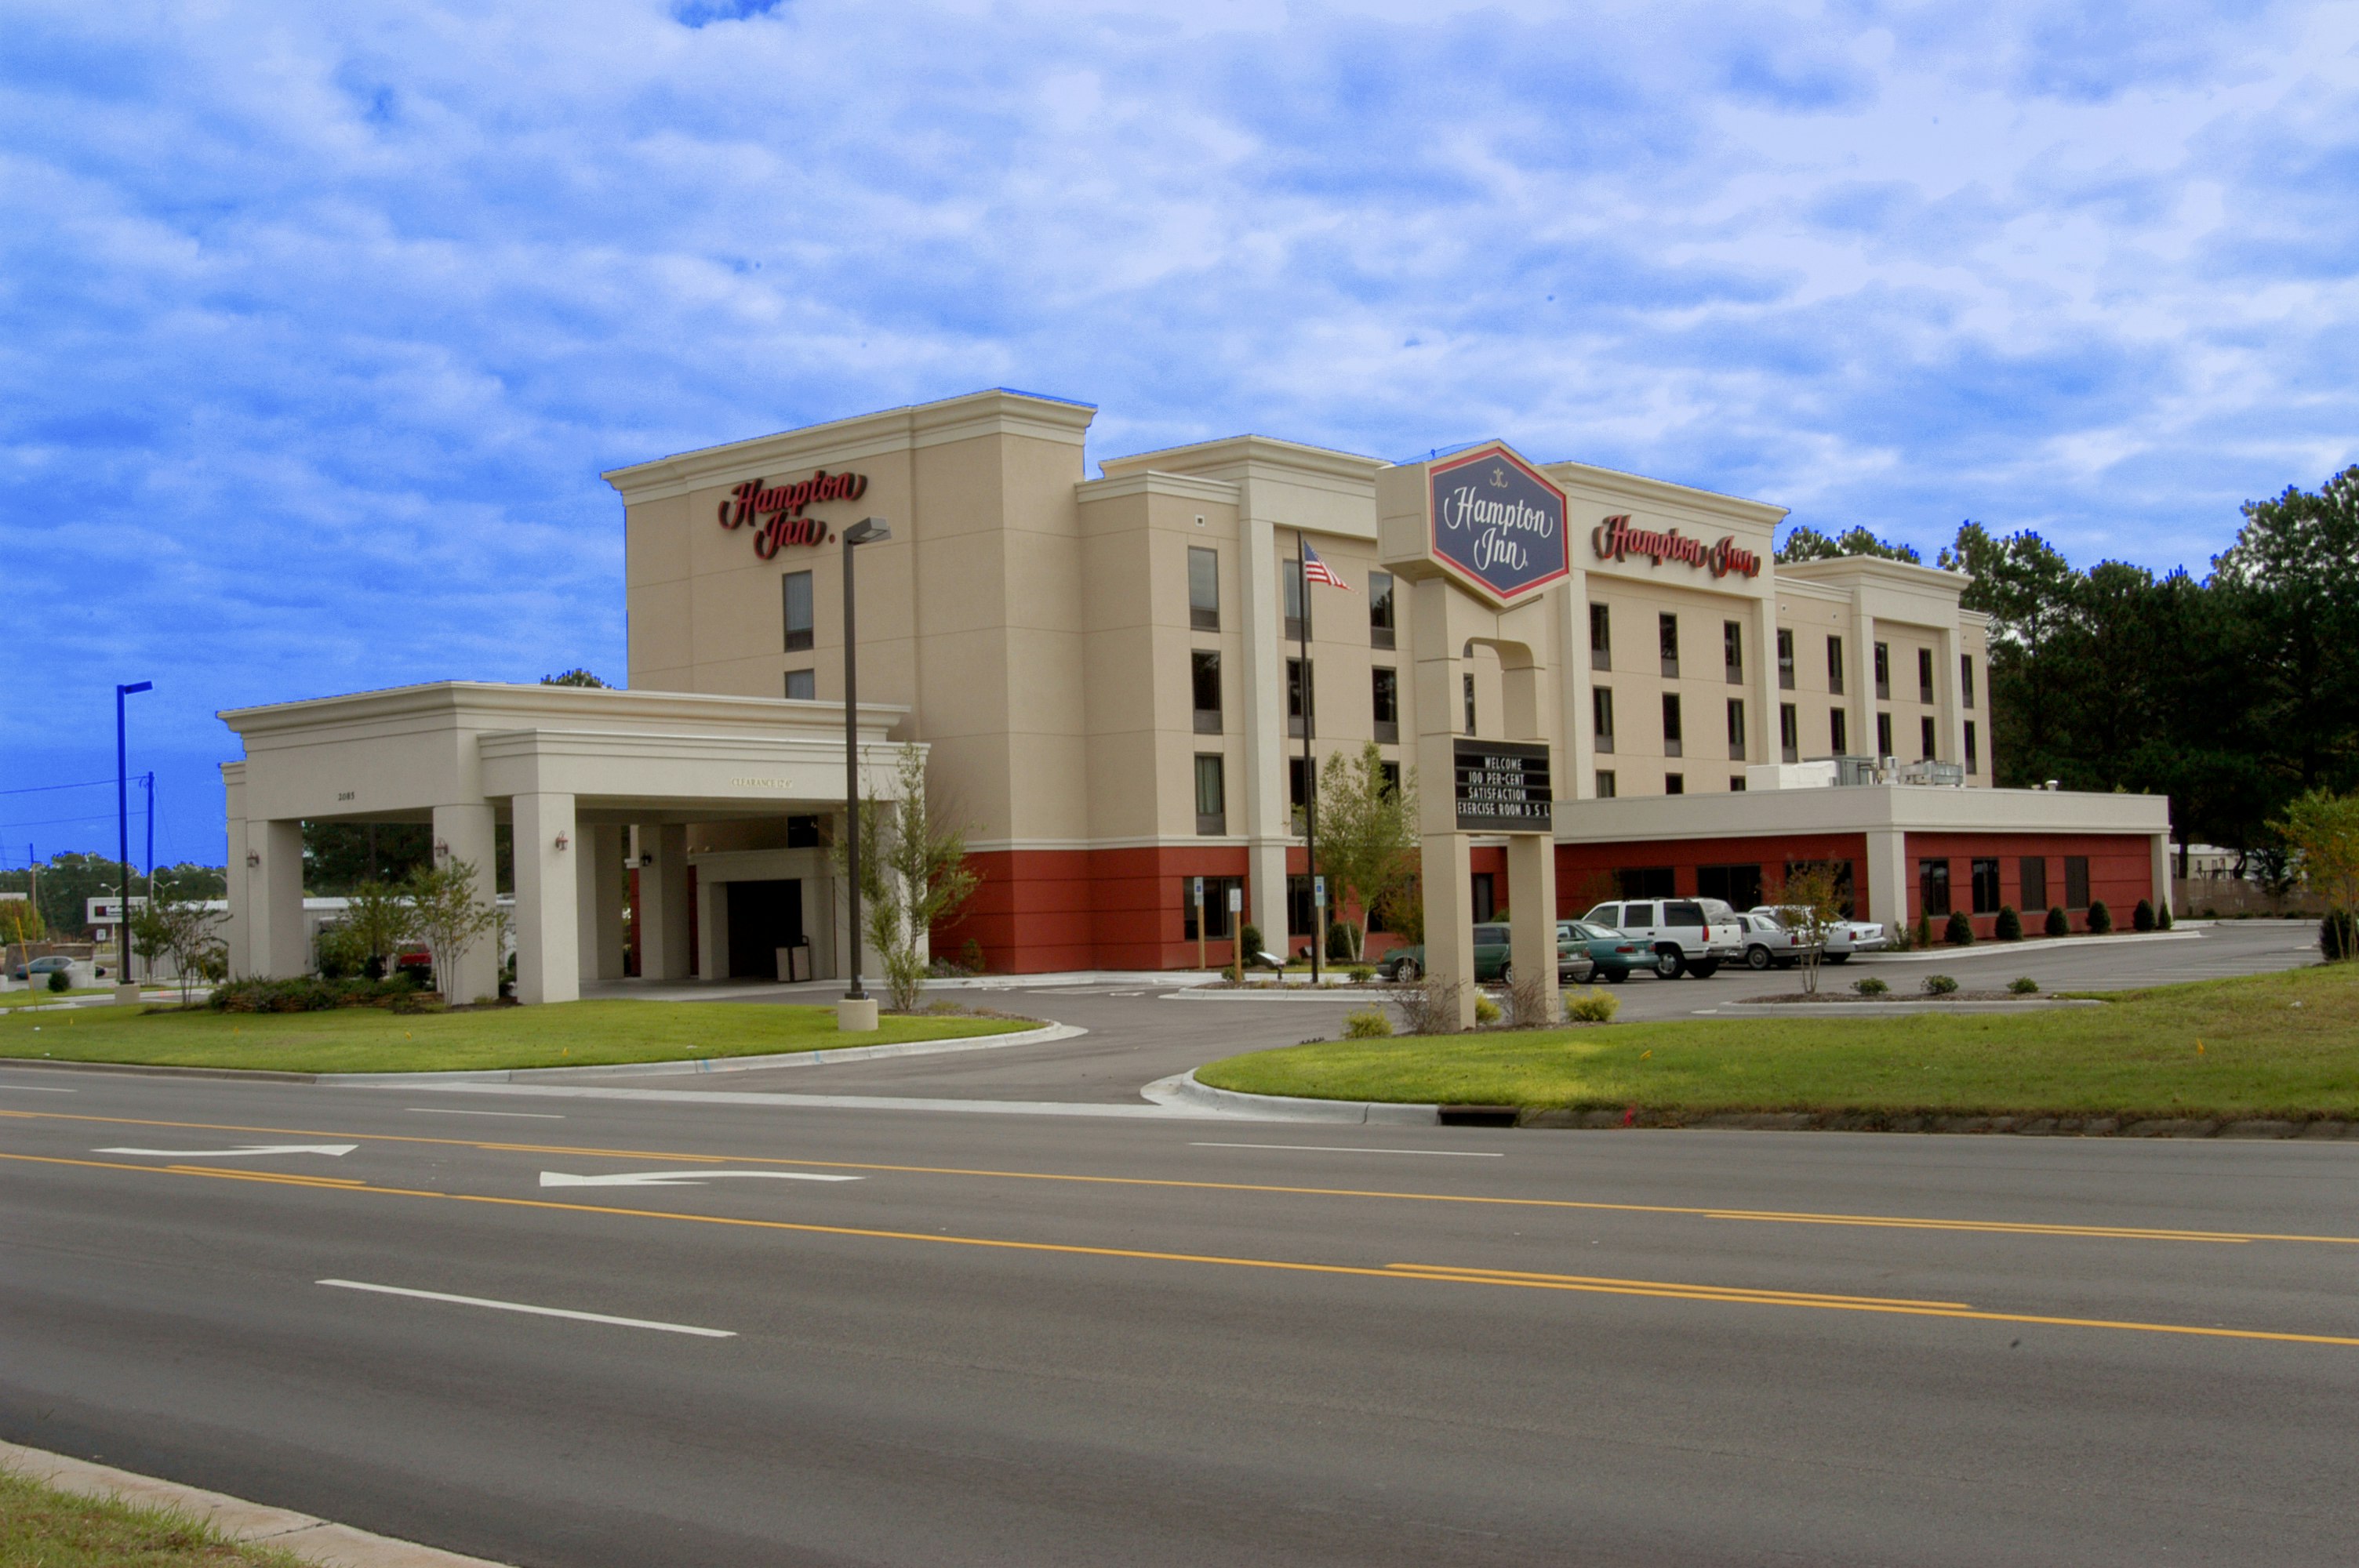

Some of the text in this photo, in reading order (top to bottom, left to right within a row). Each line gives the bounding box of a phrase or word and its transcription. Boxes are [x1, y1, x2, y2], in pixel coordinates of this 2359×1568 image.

[718, 470, 867, 530] Hampton
[1444, 485, 1553, 538] Hampton
[754, 511, 827, 560] Inn
[1474, 527, 1526, 571] Inn
[1592, 514, 1761, 578] Hampton Inn
[1469, 771, 1483, 783] 100
[1485, 757, 1521, 771] WELCOME
[1457, 801, 1495, 815] EXERCISE
[1499, 803, 1521, 816] ROOM
[1468, 786, 1527, 801] SATISFACTION
